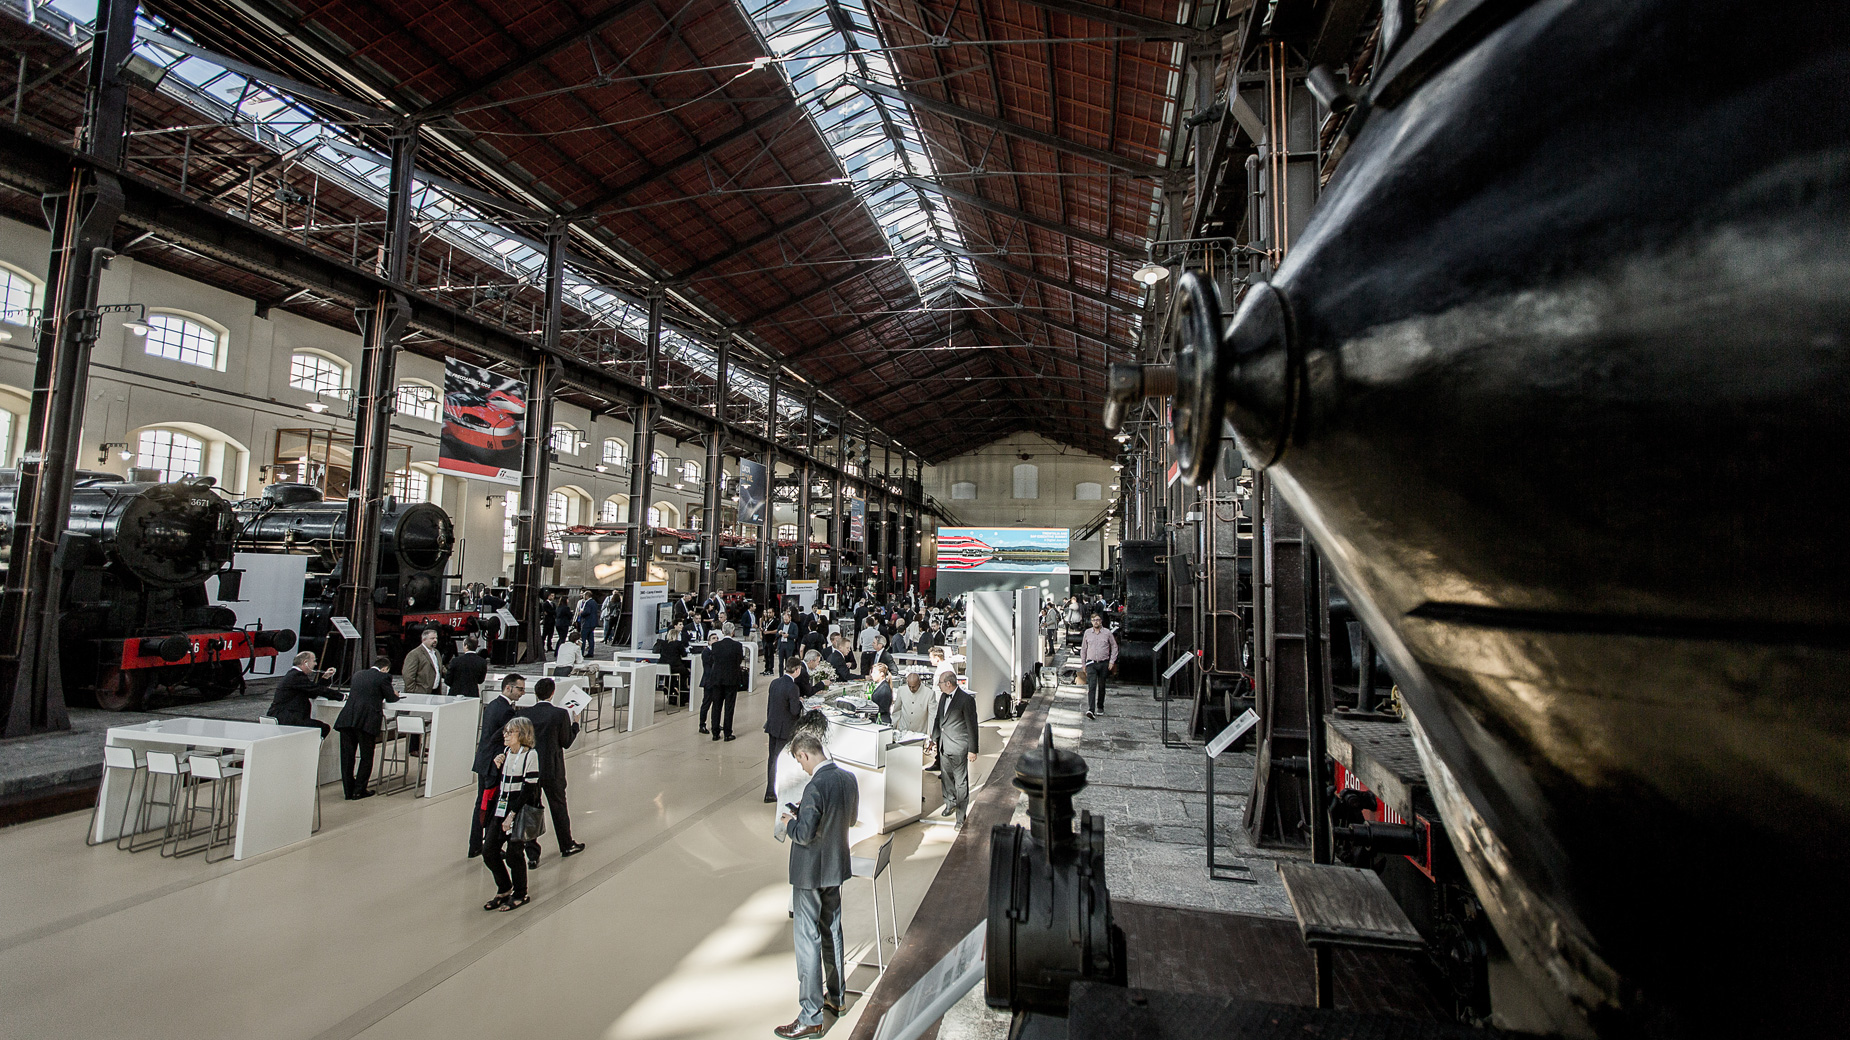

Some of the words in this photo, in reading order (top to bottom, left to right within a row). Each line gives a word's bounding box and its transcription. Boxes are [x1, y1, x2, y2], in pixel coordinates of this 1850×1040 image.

[486, 440, 494, 449] 06
[190, 498, 210, 507] 3671
[449, 617, 462, 628] 137
